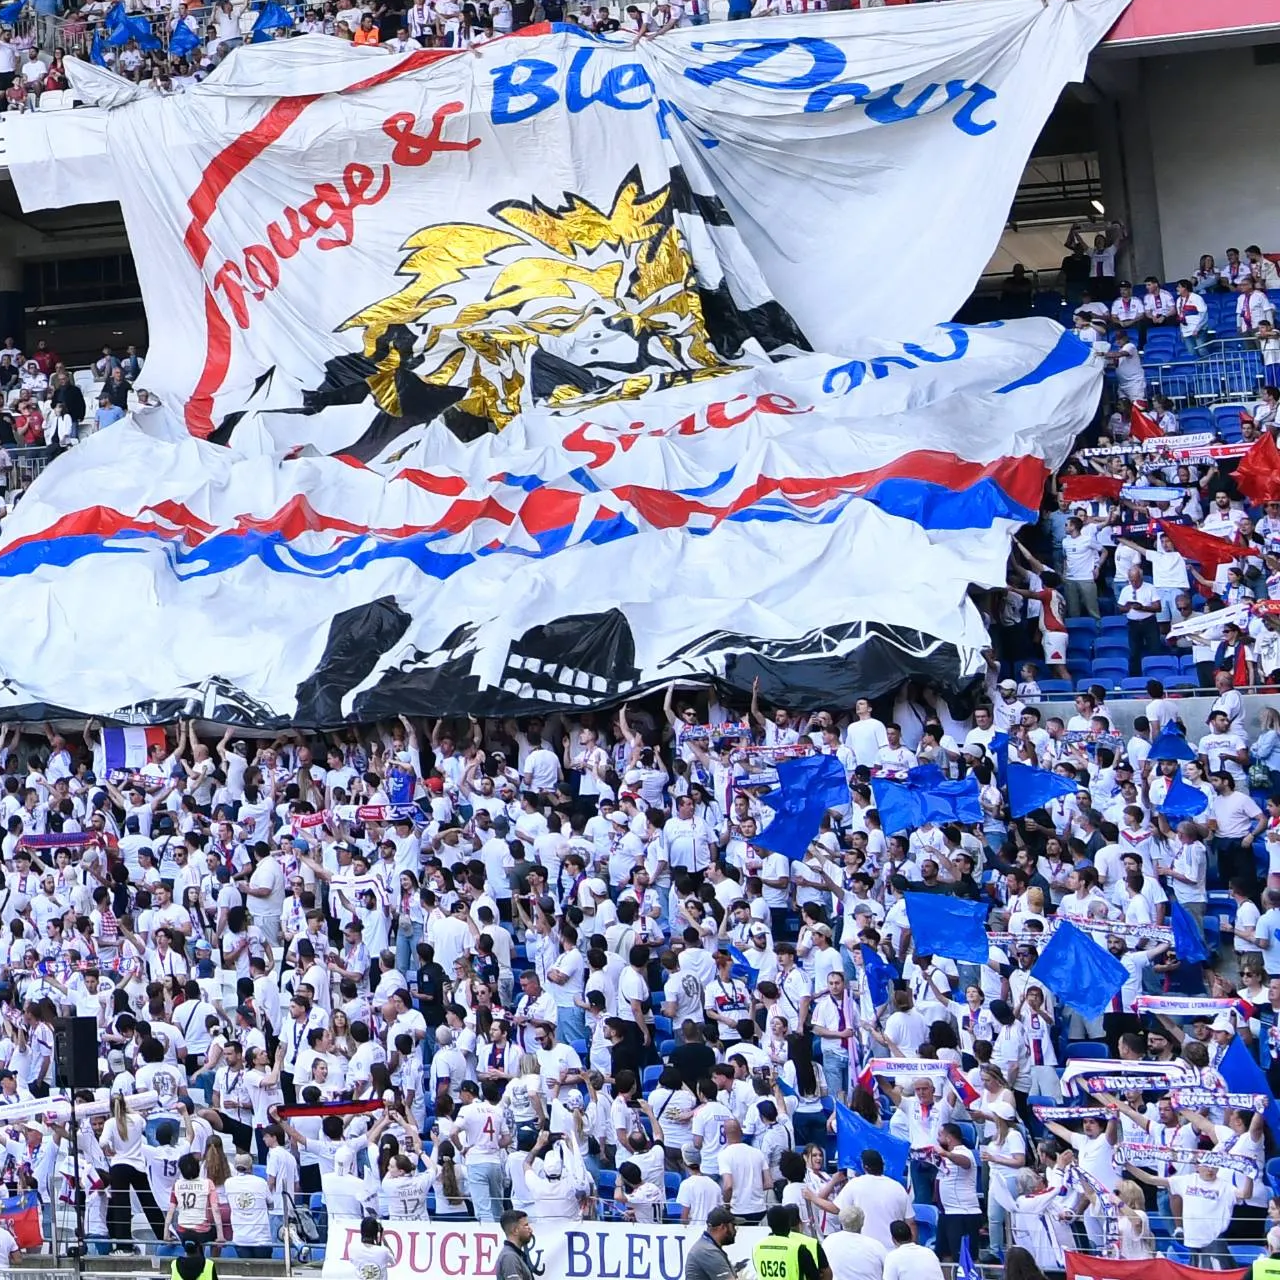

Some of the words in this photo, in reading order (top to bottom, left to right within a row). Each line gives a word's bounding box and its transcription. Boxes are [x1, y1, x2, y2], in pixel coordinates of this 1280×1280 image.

[212, 161, 391, 330] Rouge
[383, 101, 481, 166] &
[482, 1114, 496, 1137] 4
[180, 1192, 197, 1210] 10
[564, 1230, 686, 1279] BLEU
[759, 1259, 787, 1280] 0526
